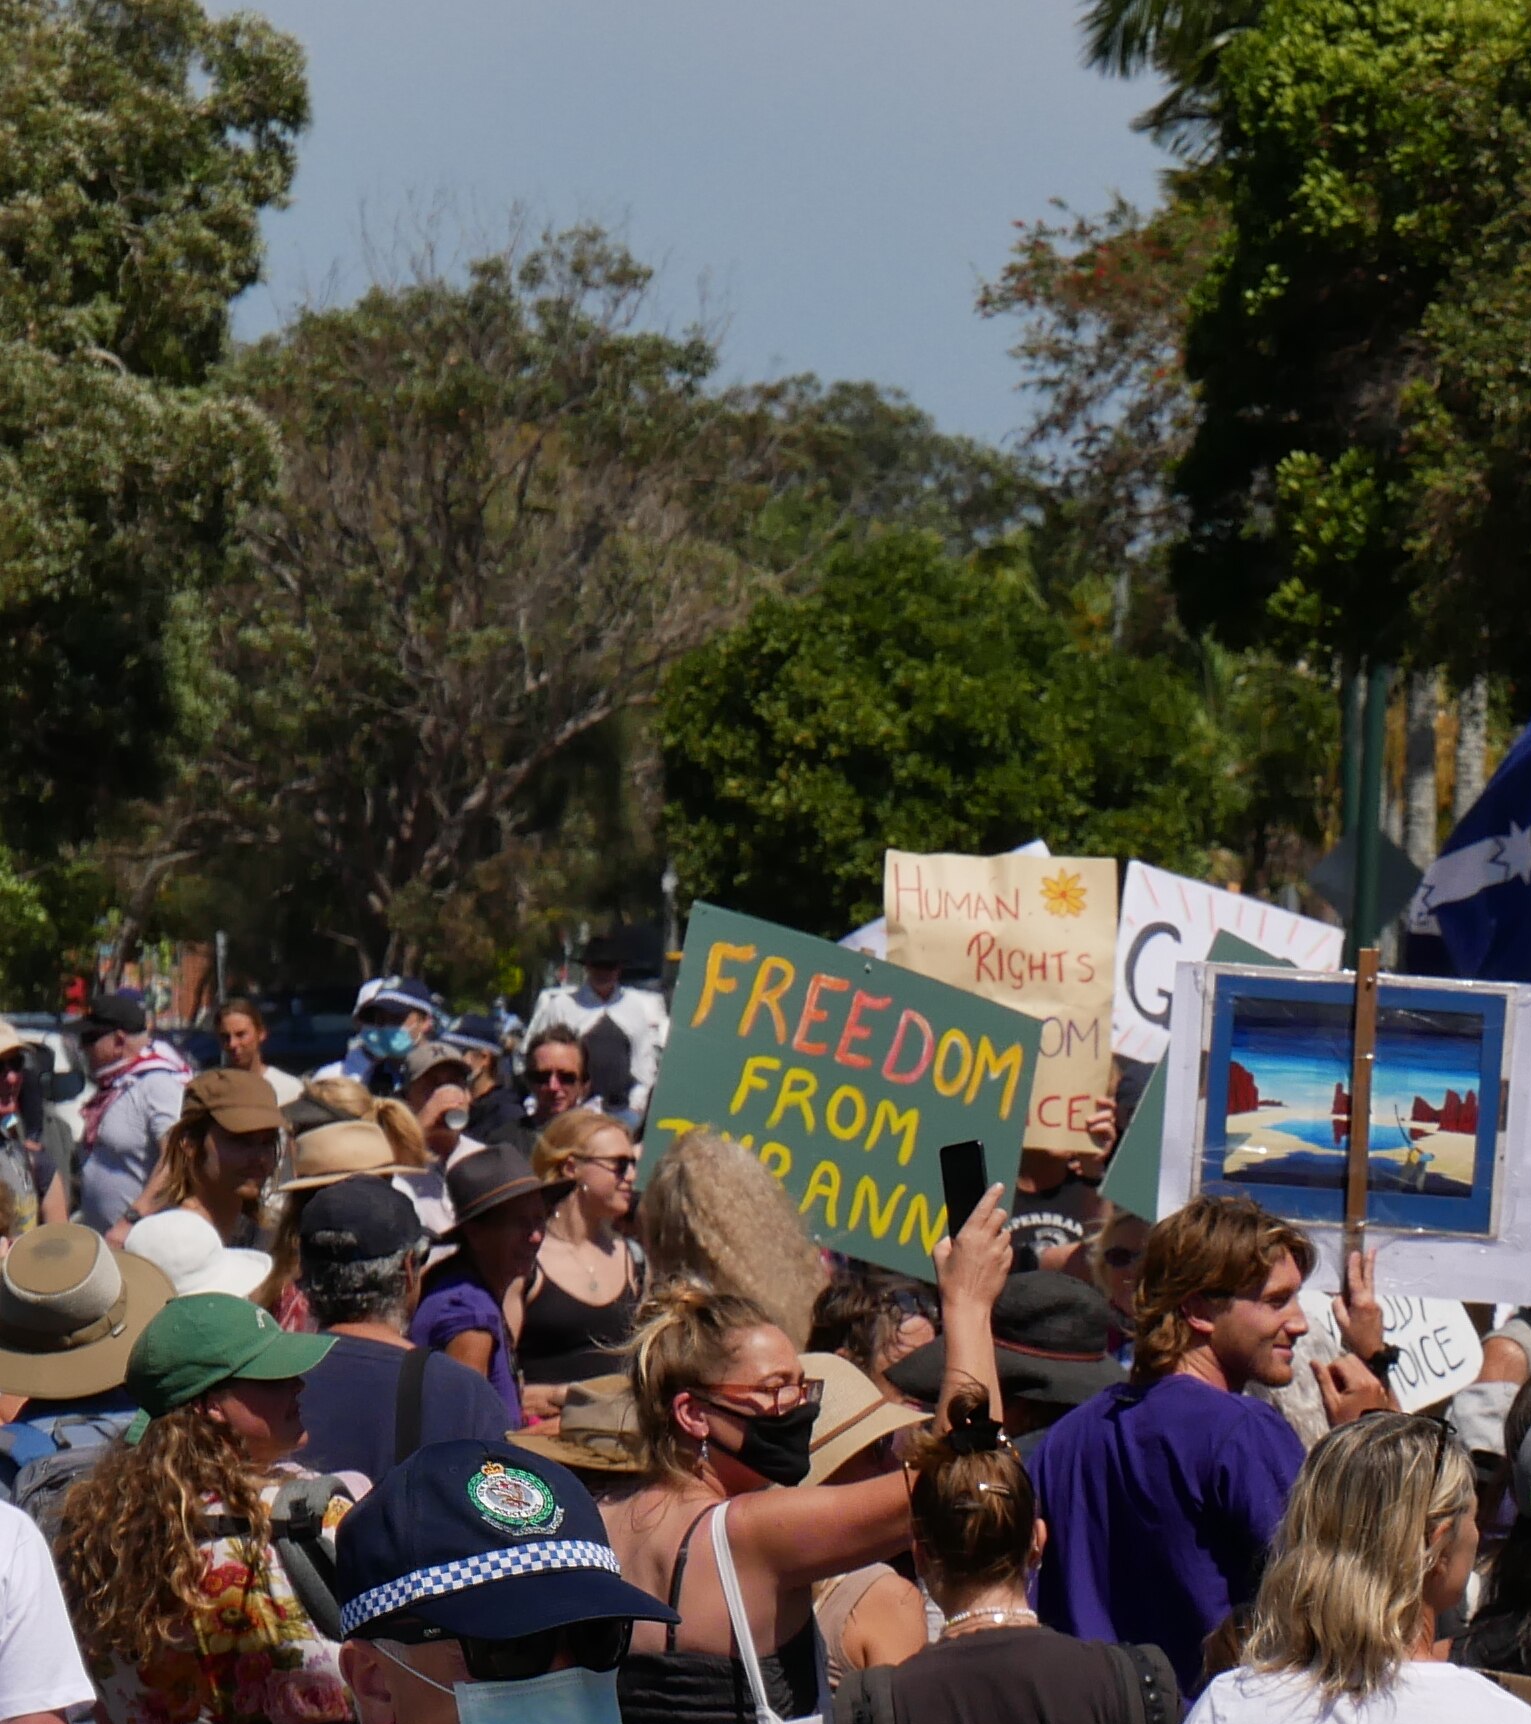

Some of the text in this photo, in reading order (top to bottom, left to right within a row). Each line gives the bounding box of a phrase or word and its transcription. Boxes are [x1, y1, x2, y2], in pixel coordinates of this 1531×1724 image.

[893, 863, 1020, 921] HUMAN
[967, 931, 1096, 991] RIGHTS
[690, 941, 1024, 1121] FREEDOM
[729, 1055, 921, 1168] FROM
